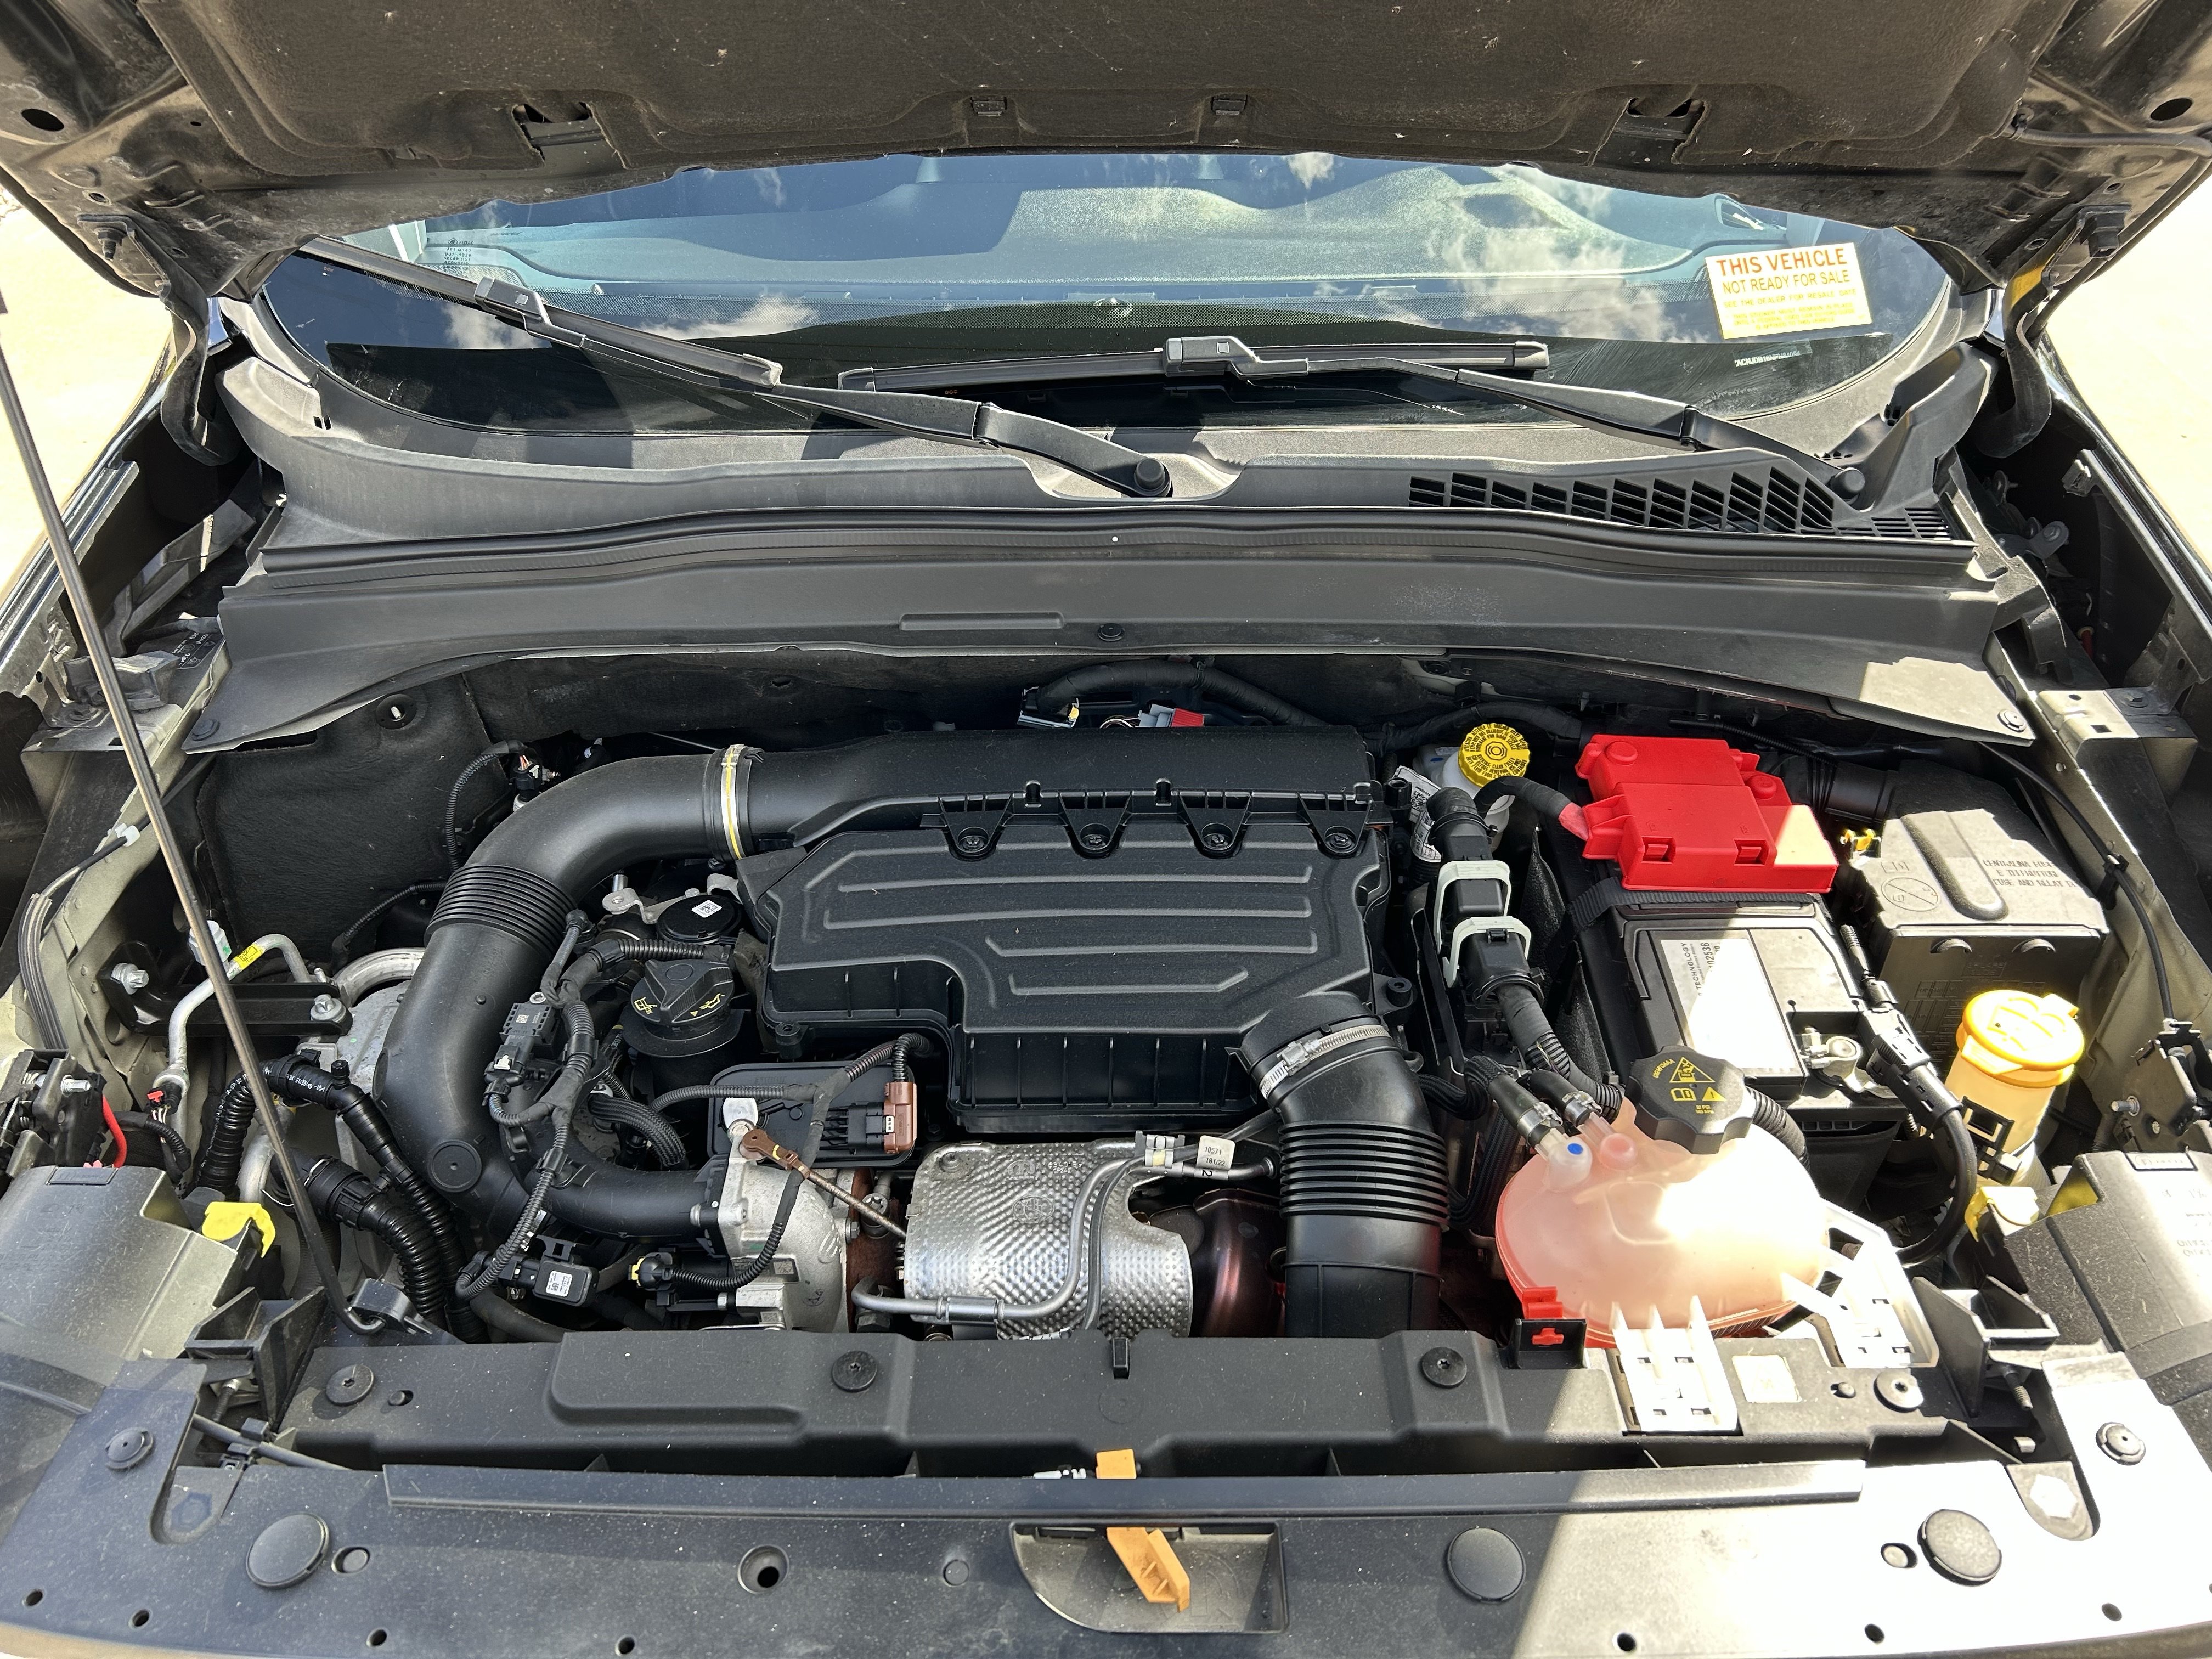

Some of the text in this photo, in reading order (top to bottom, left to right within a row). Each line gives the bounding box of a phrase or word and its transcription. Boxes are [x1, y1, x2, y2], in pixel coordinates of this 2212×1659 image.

[1716, 248, 1847, 276] THIS VEHICLE
[1723, 269, 1850, 294] NOT READY FOR SALE
[1758, 296, 1785, 304] DEALER
[1807, 290, 1835, 299] RESALE
[1680, 943, 1702, 990] TECHNOLOGY
[1205, 1146, 1222, 1155] 10571
[1206, 1158, 1226, 1166] 181/22
[1202, 1169, 1212, 1177] 2
